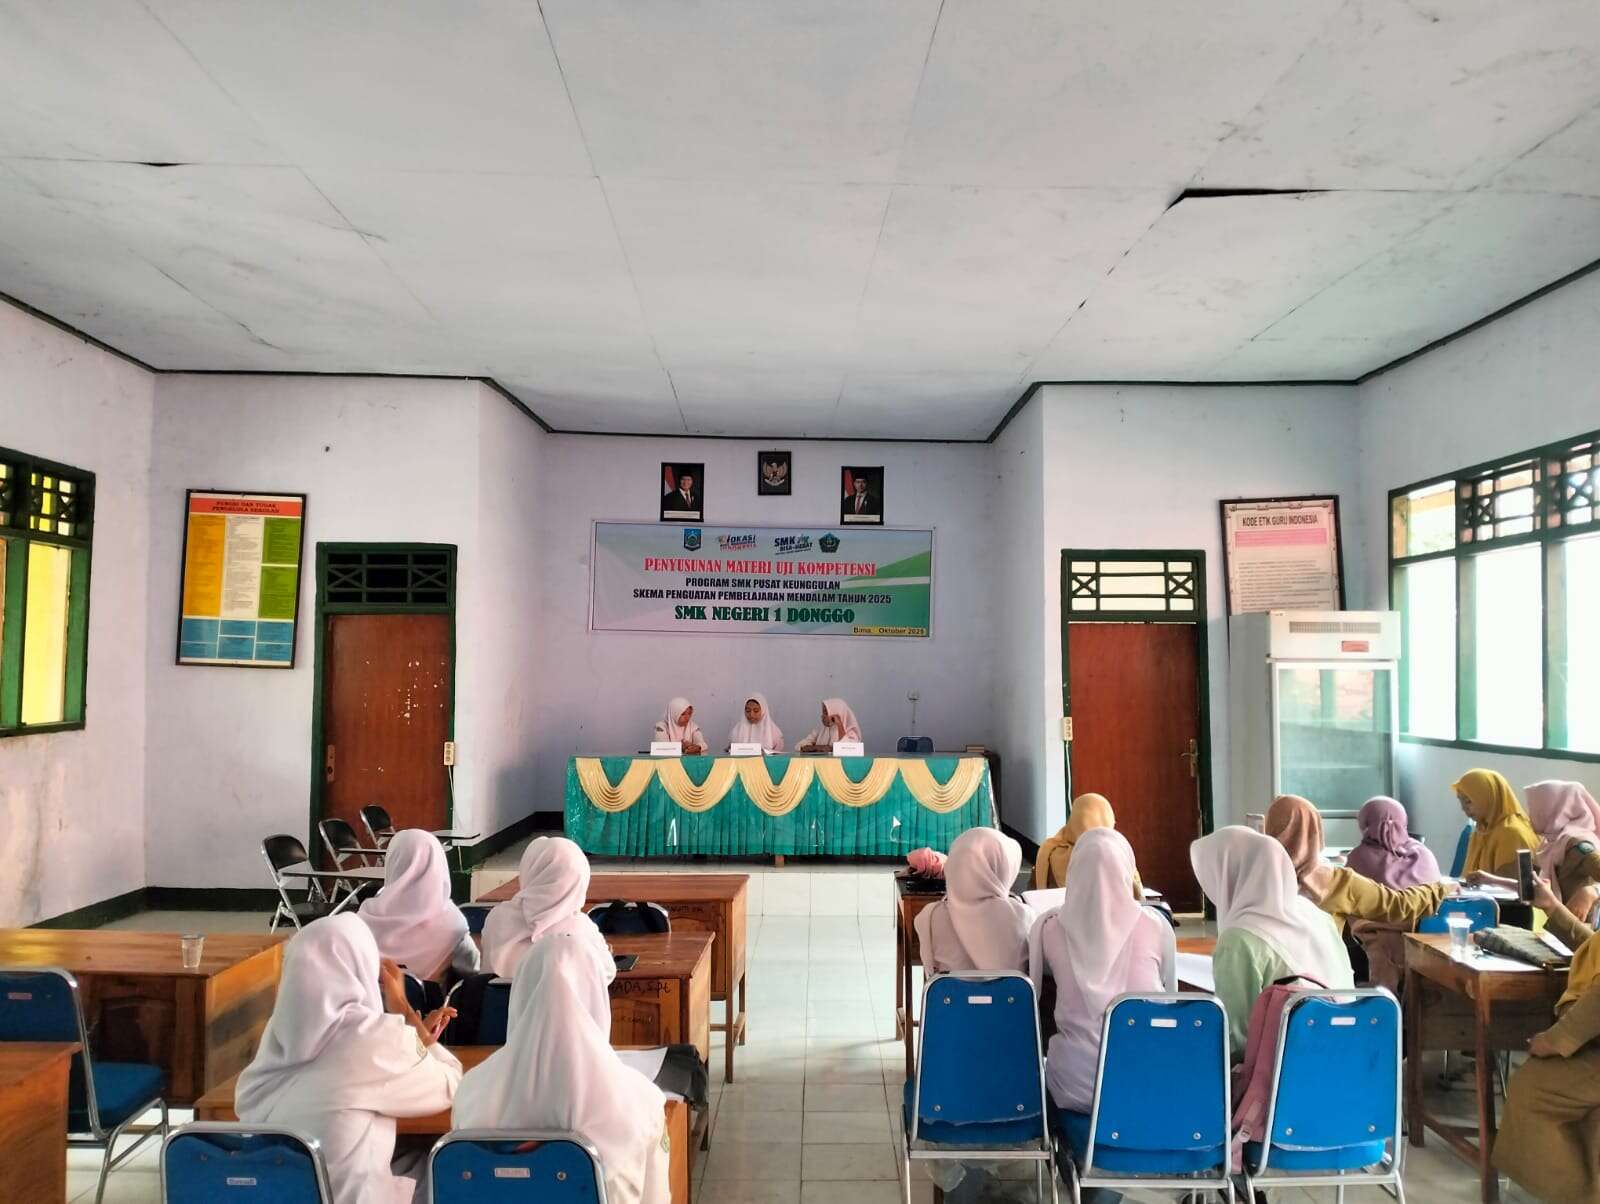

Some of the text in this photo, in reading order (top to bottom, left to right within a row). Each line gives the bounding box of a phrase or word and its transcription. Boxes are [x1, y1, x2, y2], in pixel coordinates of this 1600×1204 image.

[1242, 514, 1318, 527] KODE ETIK GURU INDONESIA
[774, 535, 796, 548] SMK
[645, 558, 877, 577] PENYUSUNAN MATERI UJI KOMPETENSI
[685, 577, 841, 591] PROGRAM SMK PUSAT KEUNGGULAN
[633, 589, 892, 604] SKEMA PENGUATAN PEMBELAJARAN MENDALAM TAHUN 2025
[674, 605, 856, 624] SMK NEGERI 1 DONGGO
